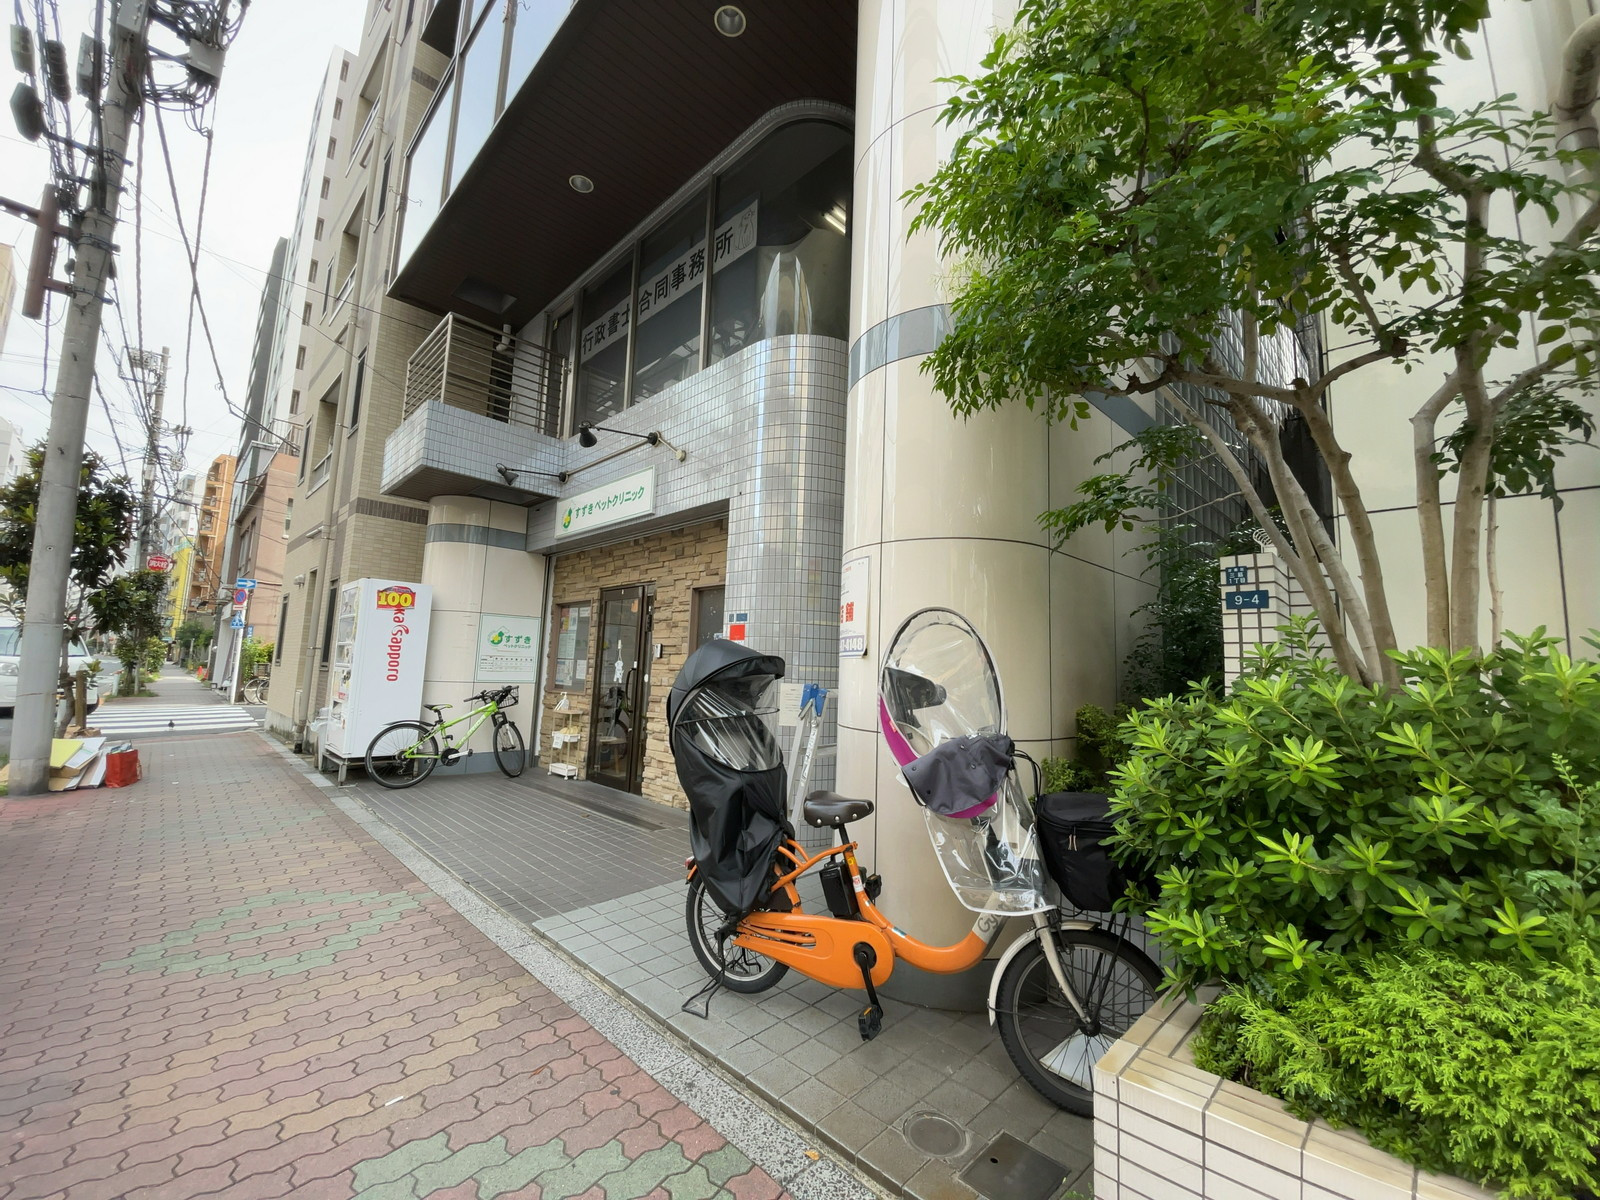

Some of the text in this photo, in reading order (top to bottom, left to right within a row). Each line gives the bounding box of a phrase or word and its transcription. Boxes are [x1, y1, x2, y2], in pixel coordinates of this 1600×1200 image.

[583, 226, 734, 355] 行政書士合同事務所
[575, 486, 645, 518] すずきペットクリニック
[378, 591, 412, 607] 100
[1234, 594, 1260, 605] 9-4
[504, 634, 532, 645] すずき
[386, 630, 403, 681] sapporo
